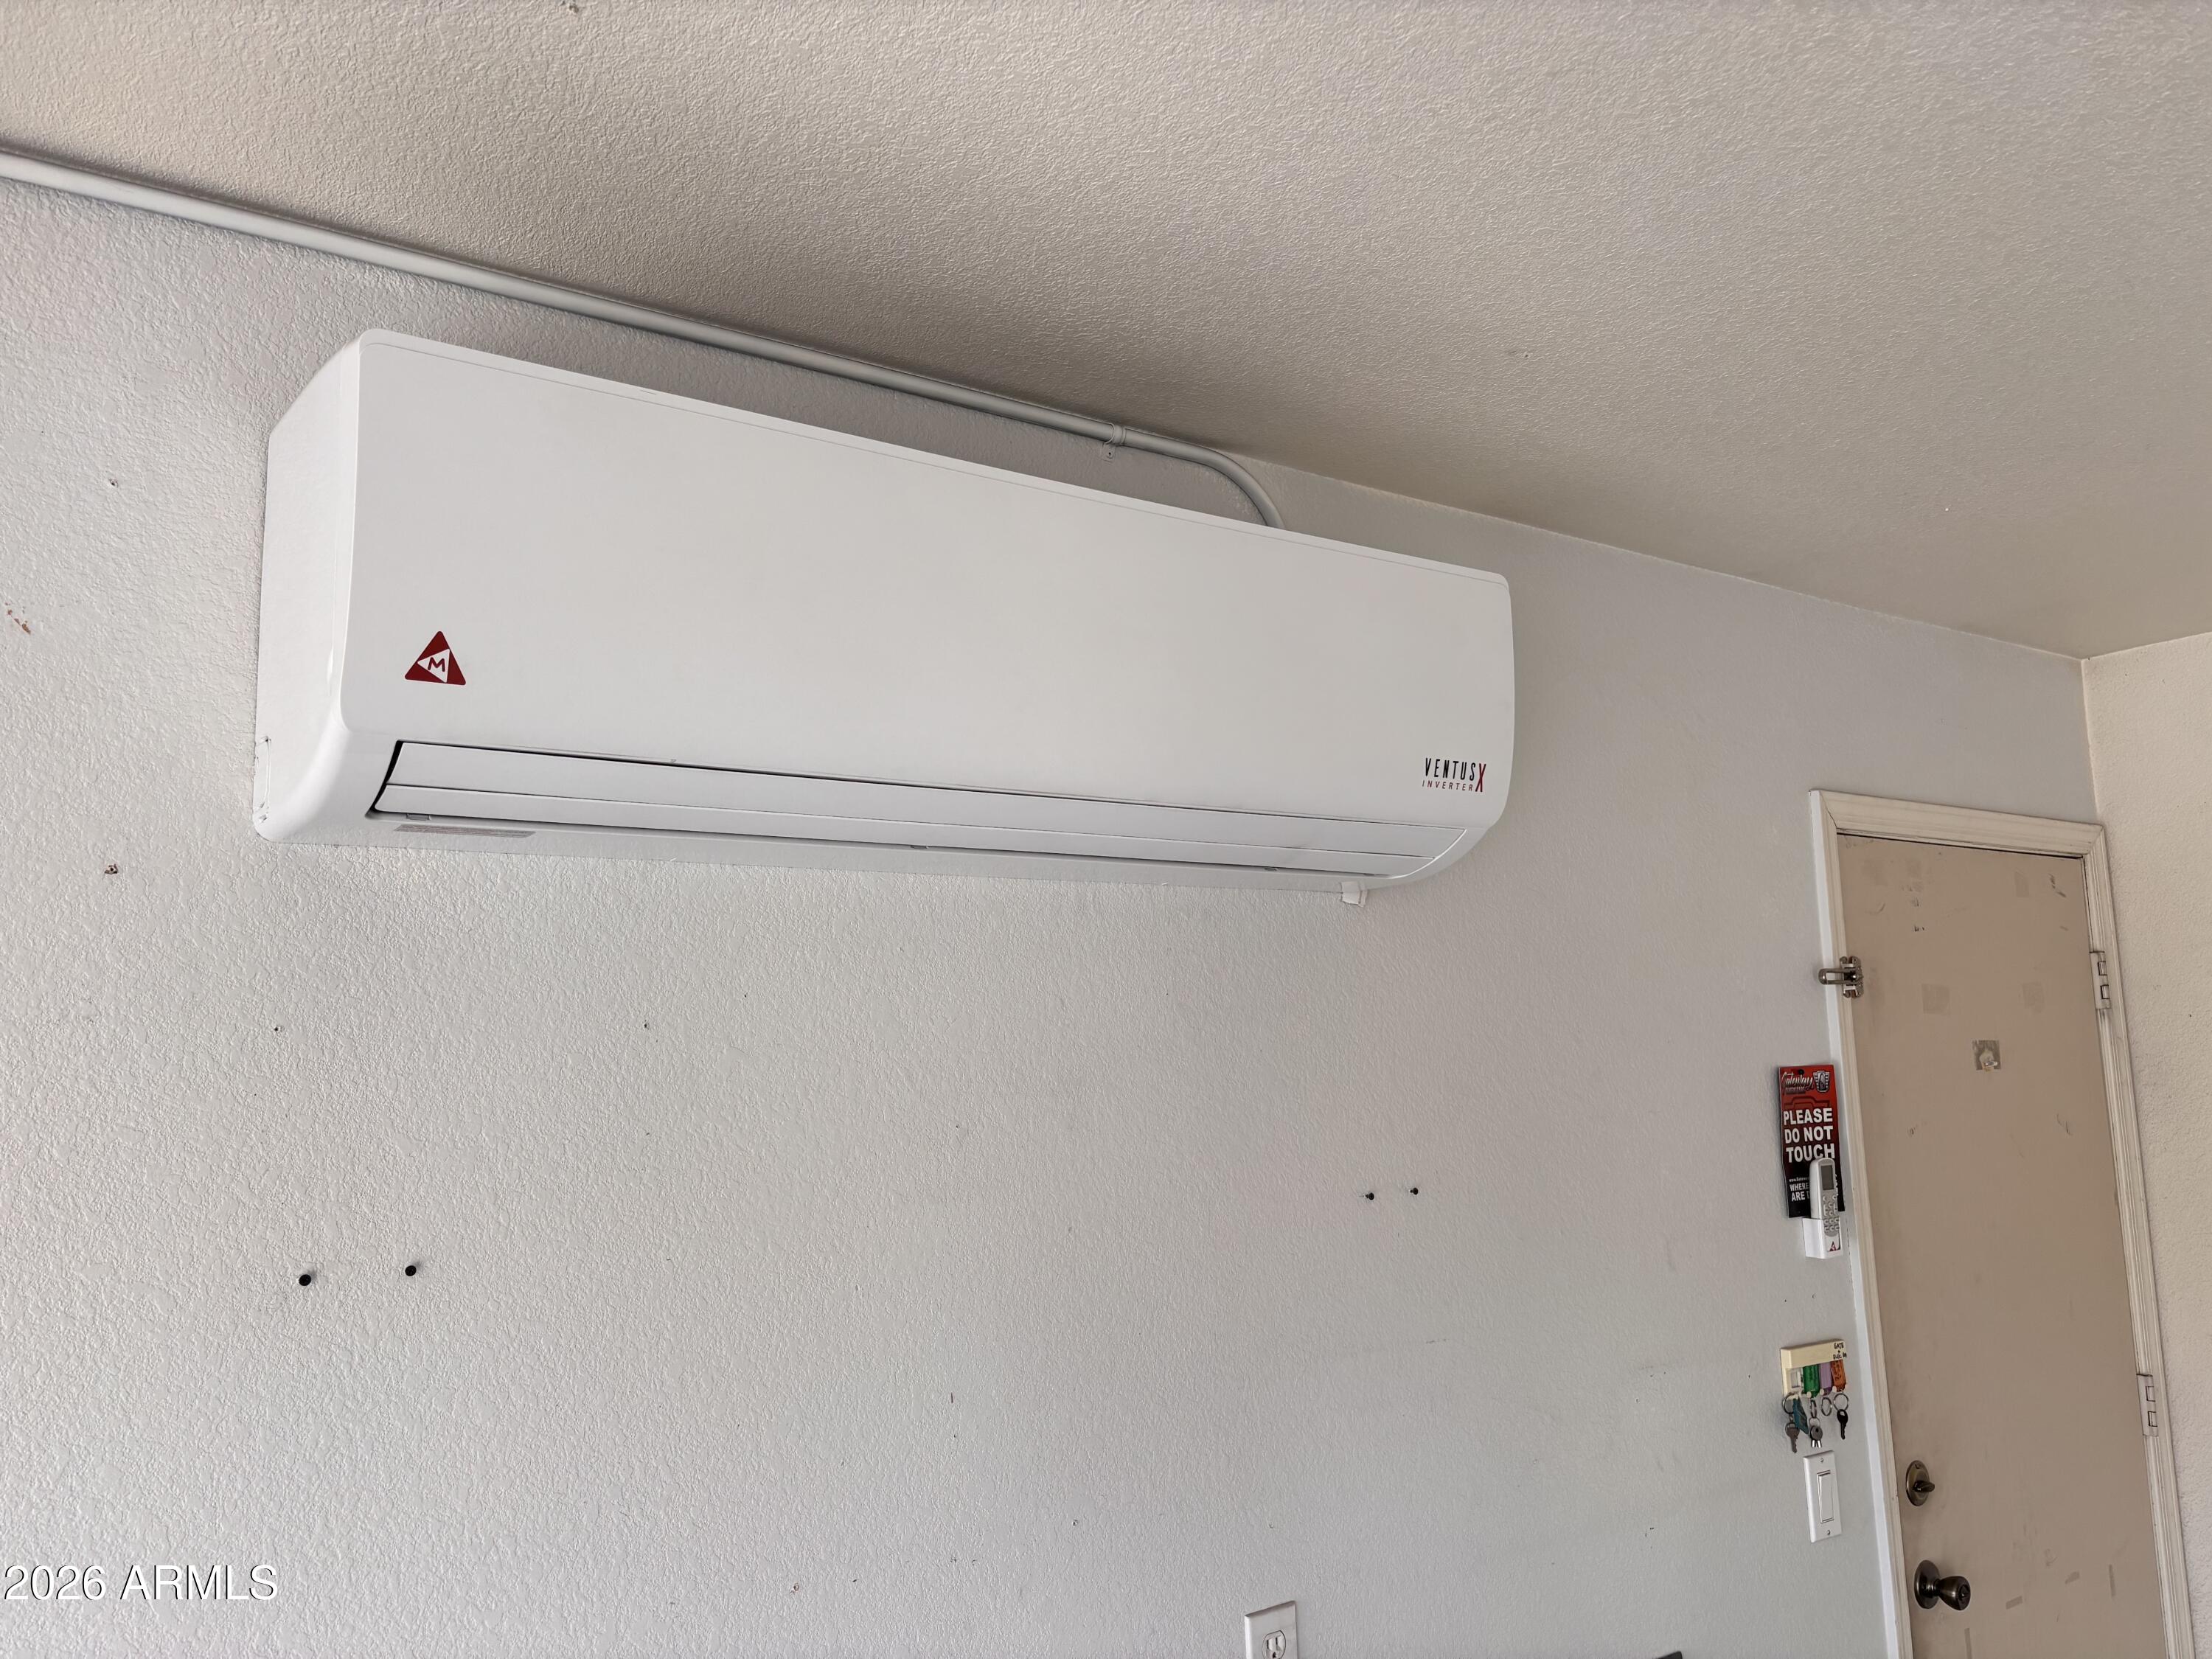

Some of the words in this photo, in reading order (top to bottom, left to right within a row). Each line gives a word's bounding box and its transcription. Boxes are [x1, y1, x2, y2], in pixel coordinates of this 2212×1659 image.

[428, 657, 445, 672] M
[1422, 780, 1473, 791] INVERTER
[1784, 1107, 1833, 1125] PLEASE
[1784, 1128, 1800, 1144] DO
[1804, 1125, 1834, 1142] NOT
[1786, 1143, 1835, 1164] TOUCH
[1790, 1183, 1809, 1192] WHERE
[1792, 1192, 1806, 1202] ARE
